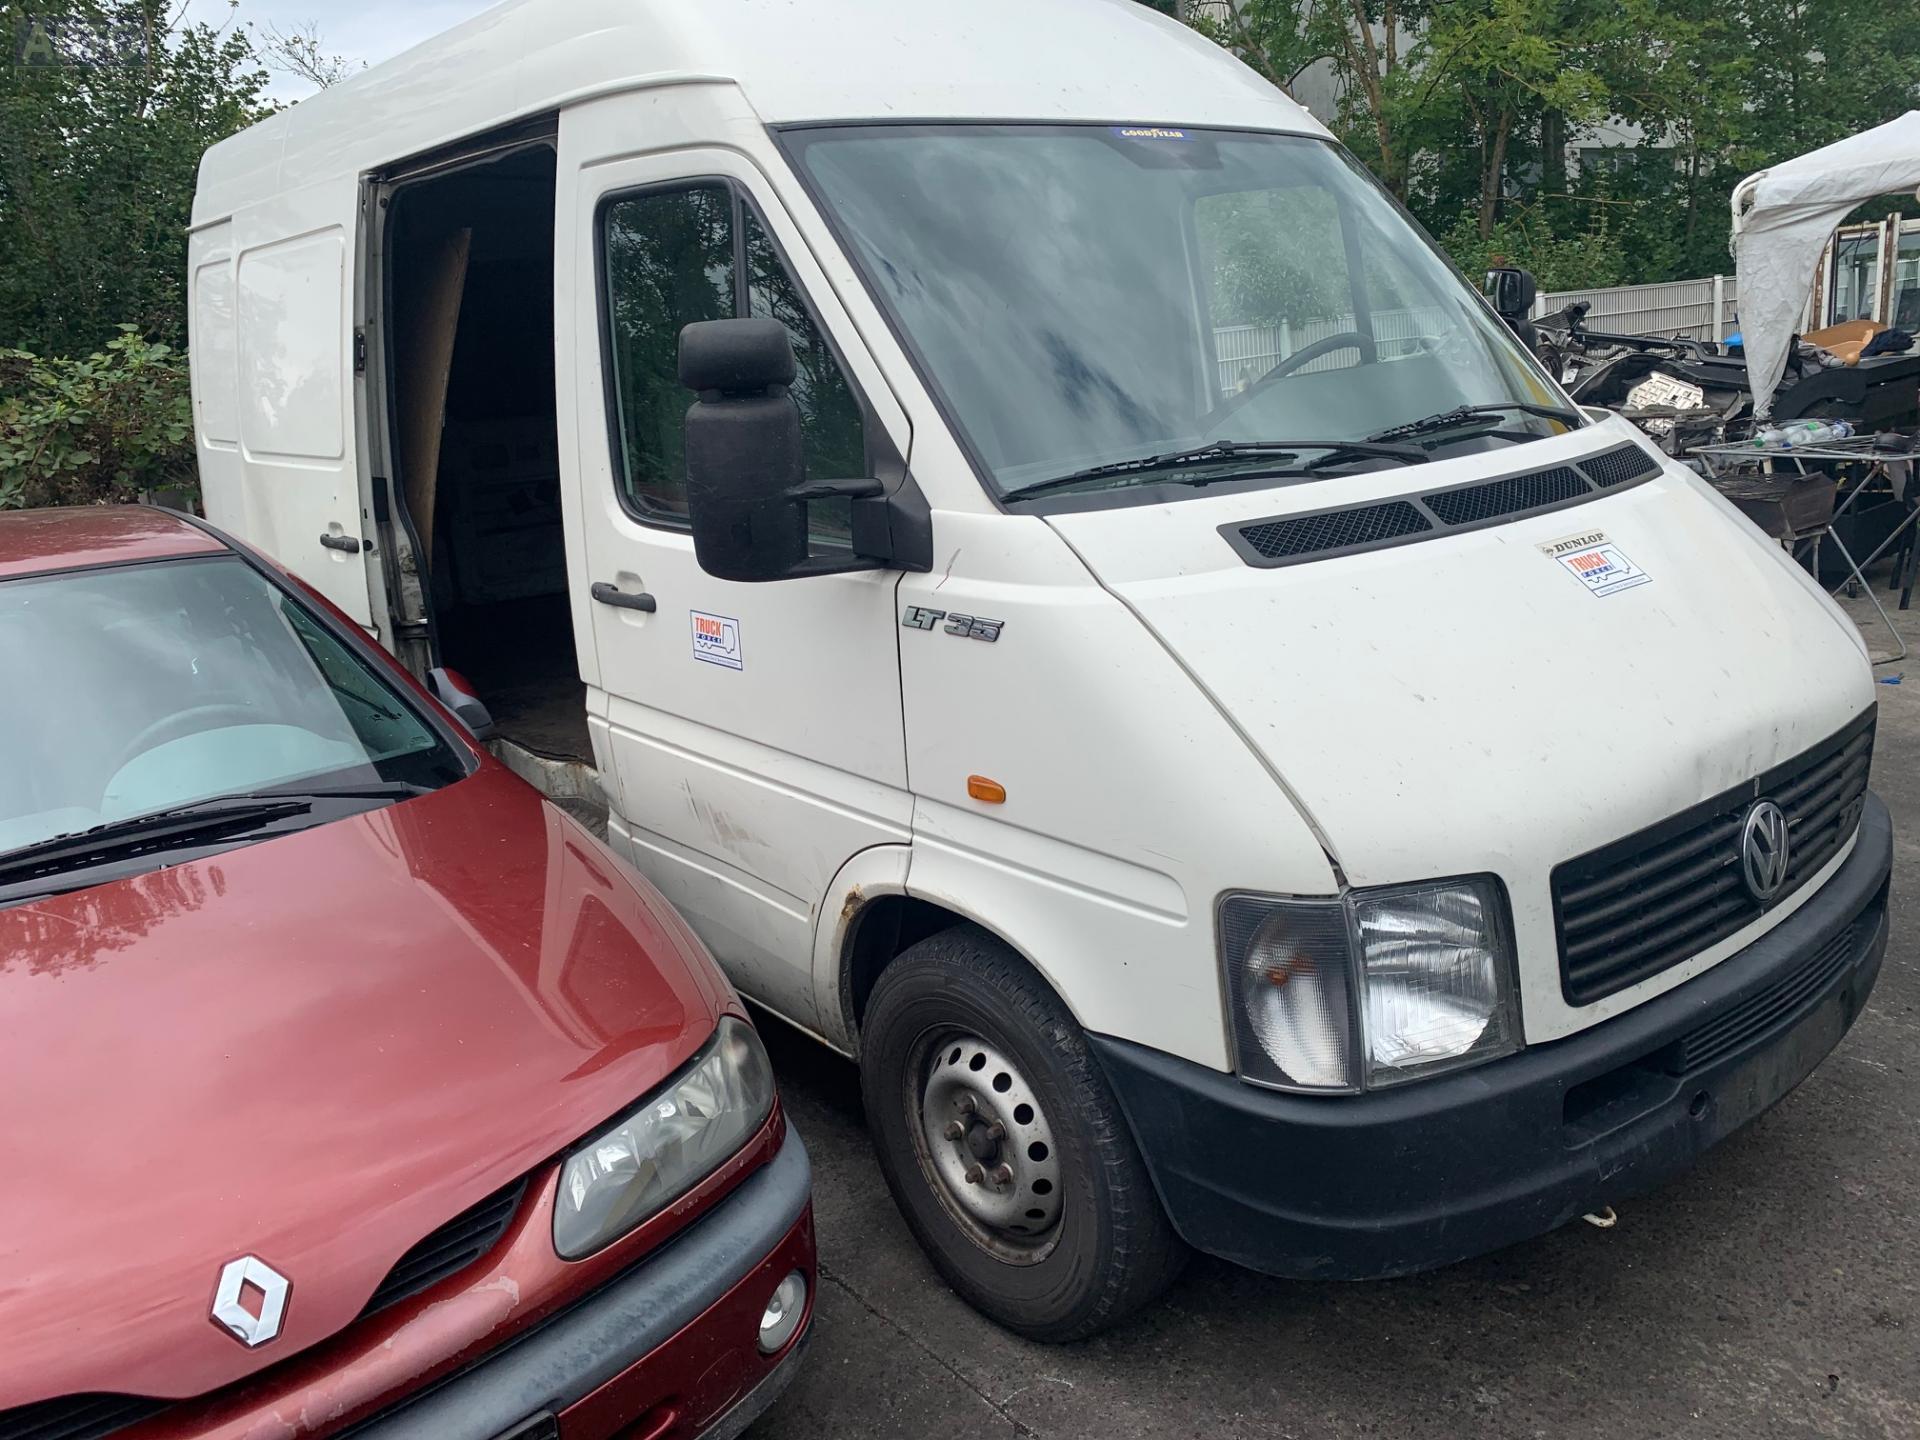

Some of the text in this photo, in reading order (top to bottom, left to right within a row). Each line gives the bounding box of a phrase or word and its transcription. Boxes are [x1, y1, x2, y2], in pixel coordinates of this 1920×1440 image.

[1121, 128, 1184, 138] GOODYEAR
[1554, 532, 1604, 553] DUNLOP
[1567, 552, 1608, 573] TRUCK
[695, 617, 721, 637] TRUCK
[902, 605, 1005, 642] LT 35
